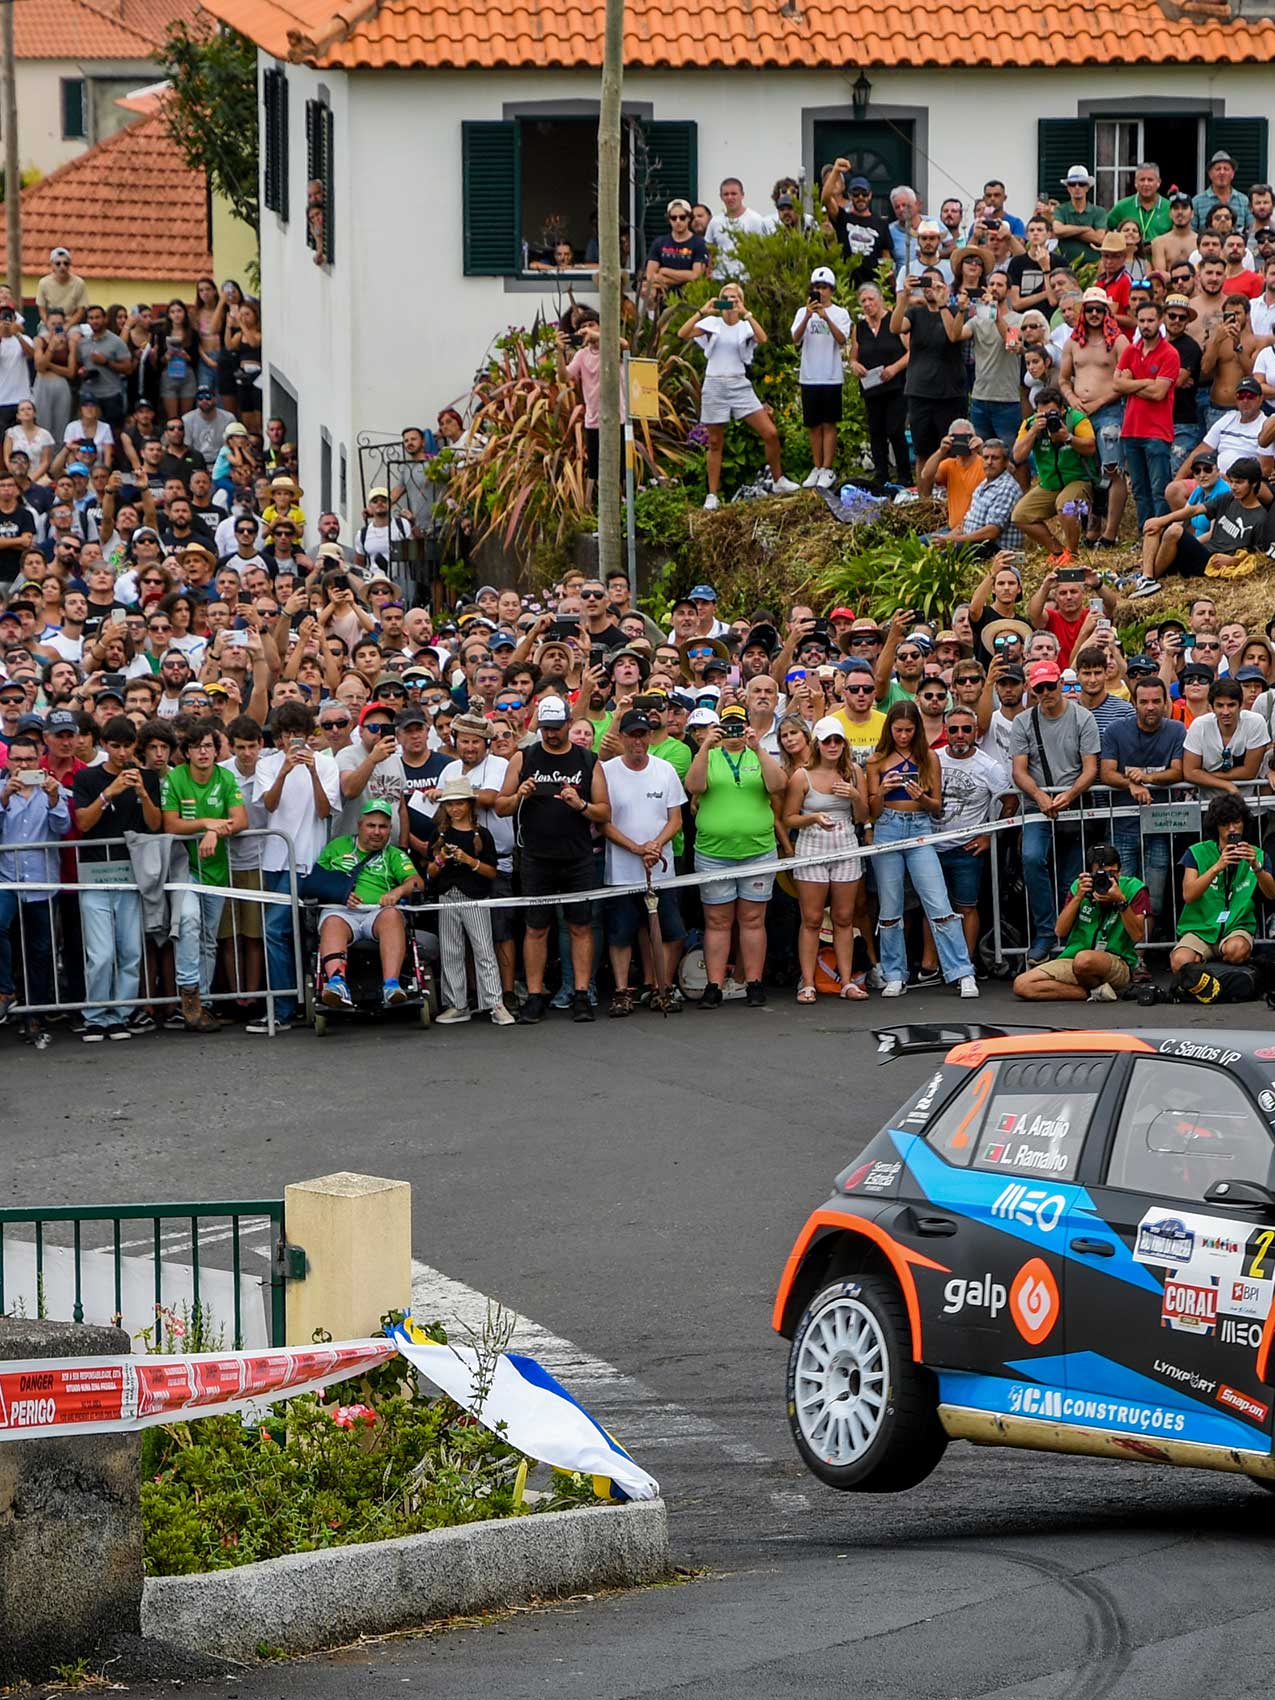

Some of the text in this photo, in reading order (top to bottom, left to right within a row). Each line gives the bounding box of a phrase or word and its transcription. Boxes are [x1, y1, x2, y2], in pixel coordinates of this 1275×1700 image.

[1218, 515, 1241, 539] PUMA
[406, 777, 438, 788] OMMY
[1174, 1041, 1220, 1060] Santos
[1220, 1049, 1242, 1066] VP
[951, 1070, 994, 1149] 2
[1012, 1113, 1070, 1143] A. Araújo
[1001, 1144, 1069, 1172] L. Ramalho
[991, 1183, 1067, 1232] MEO
[1248, 1230, 1275, 1278] 2
[943, 1273, 1007, 1318] galp
[1165, 1285, 1217, 1319] CORAL
[1243, 1288, 1260, 1302] BPI
[1221, 1319, 1263, 1348] MEO
[19, 1374, 54, 1392] DANGER
[1153, 1359, 1216, 1394] LYNXPORT
[10, 1397, 56, 1426] PERIGO
[1063, 1397, 1185, 1431] CONSTRUÇÕES
